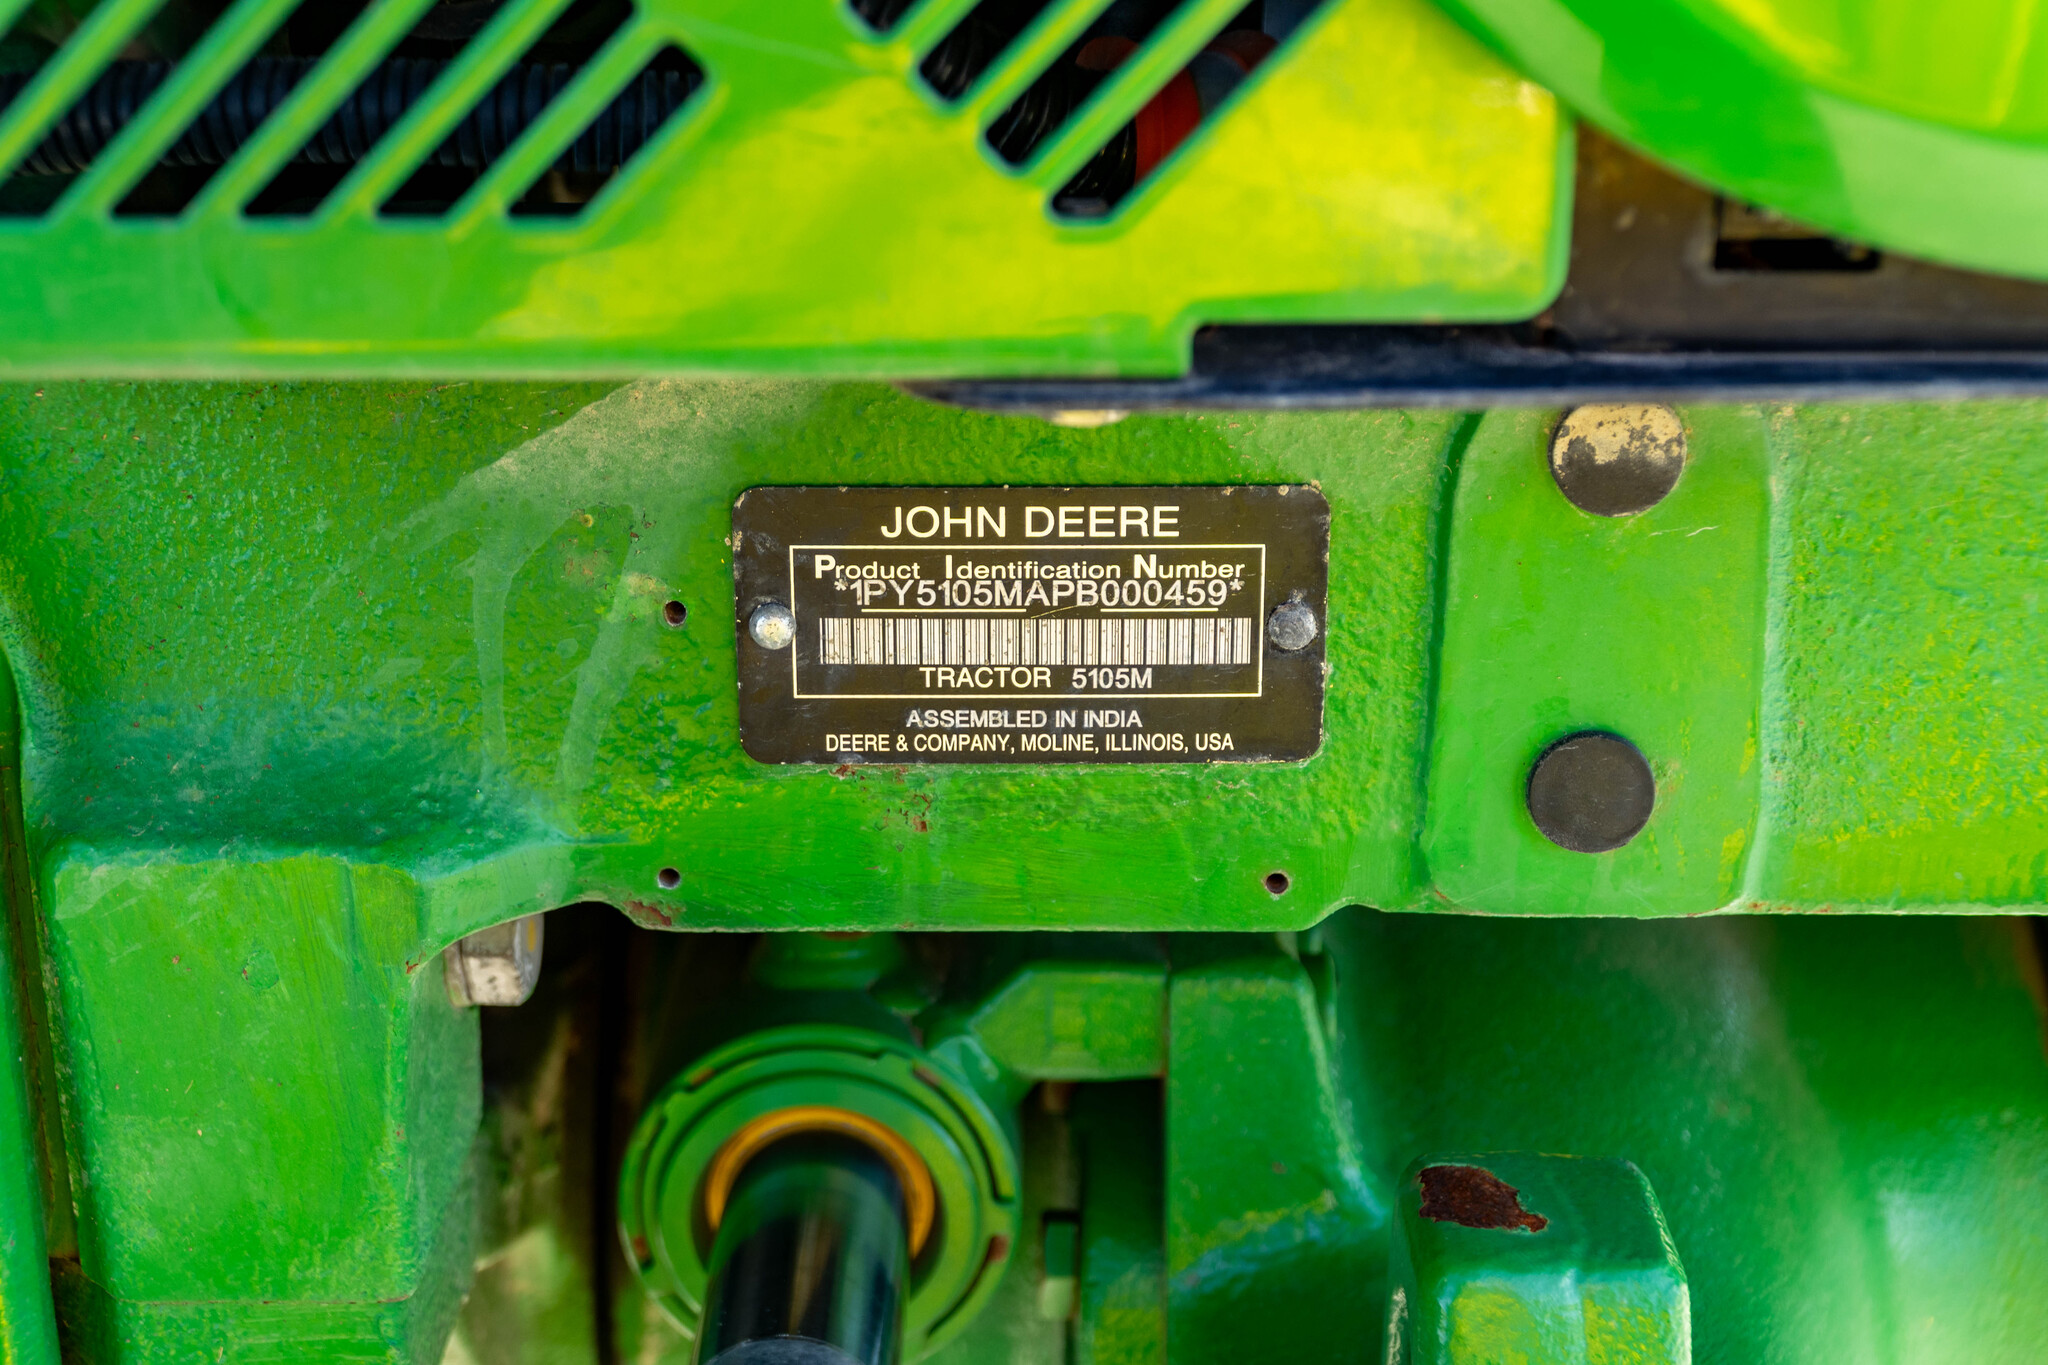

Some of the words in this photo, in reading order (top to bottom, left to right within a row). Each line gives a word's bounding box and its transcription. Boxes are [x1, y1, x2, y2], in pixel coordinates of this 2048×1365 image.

[881, 505, 1006, 538] JOHN
[1024, 505, 1180, 538] DEERE
[814, 554, 921, 580] Product
[945, 554, 1121, 580] Identification
[1133, 553, 1246, 579] Number
[919, 666, 1052, 689] TRACTOR
[1071, 667, 1153, 689] 5105M
[905, 709, 1048, 728] ASSEMBLED
[1055, 709, 1077, 728] IN
[1083, 709, 1143, 728] INDIA
[825, 733, 891, 752] DEERE
[895, 733, 909, 752] &
[913, 733, 1015, 755] COMPANY,
[1021, 733, 1099, 754] MOLINE,
[1105, 732, 1189, 754] ILLINOIS,
[1195, 732, 1235, 751] USA
